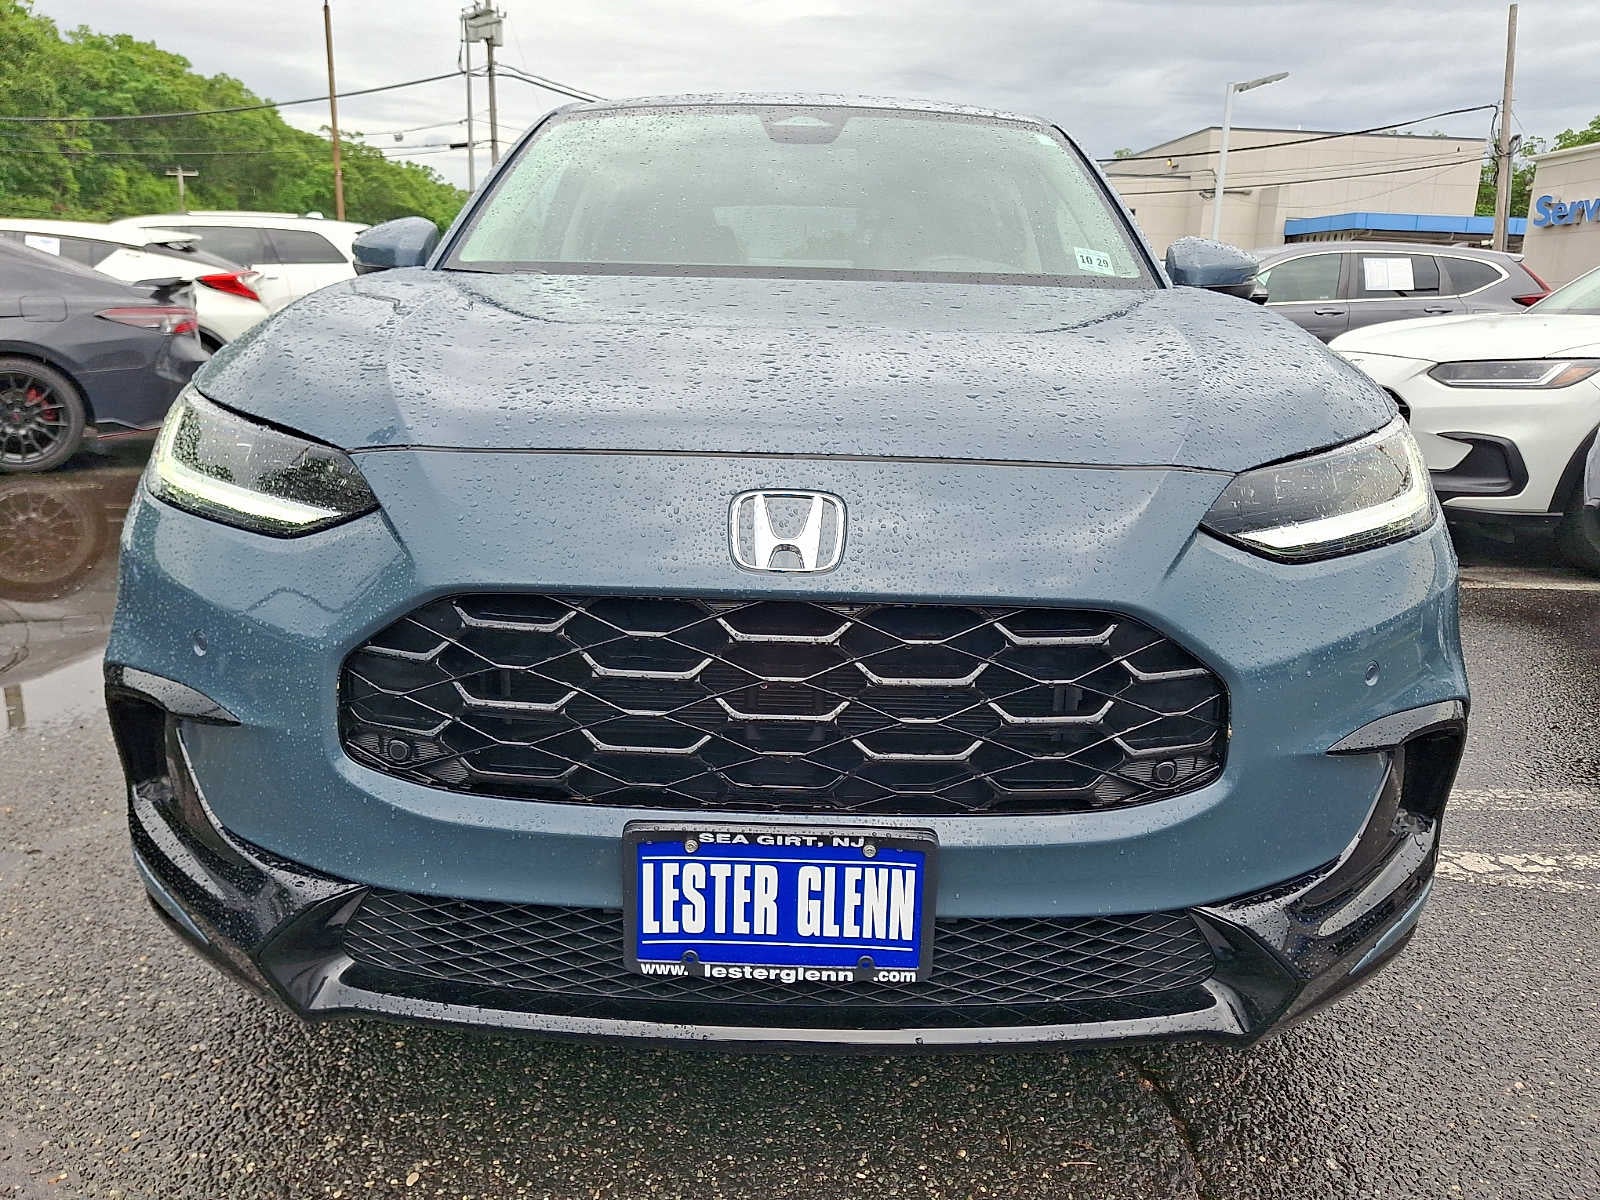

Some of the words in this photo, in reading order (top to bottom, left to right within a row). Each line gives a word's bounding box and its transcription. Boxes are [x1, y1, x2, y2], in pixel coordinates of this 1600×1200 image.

[1079, 254, 1093, 265] 10
[1097, 257, 1109, 268] 29
[698, 832, 747, 845] SEA
[756, 835, 824, 847] GIRT,
[832, 837, 865, 848] NJ
[642, 862, 779, 935] LESTER
[797, 865, 916, 941] GLENN
[640, 963, 689, 976] www.
[704, 964, 854, 984] lesterglenn
[873, 970, 917, 983] .com
